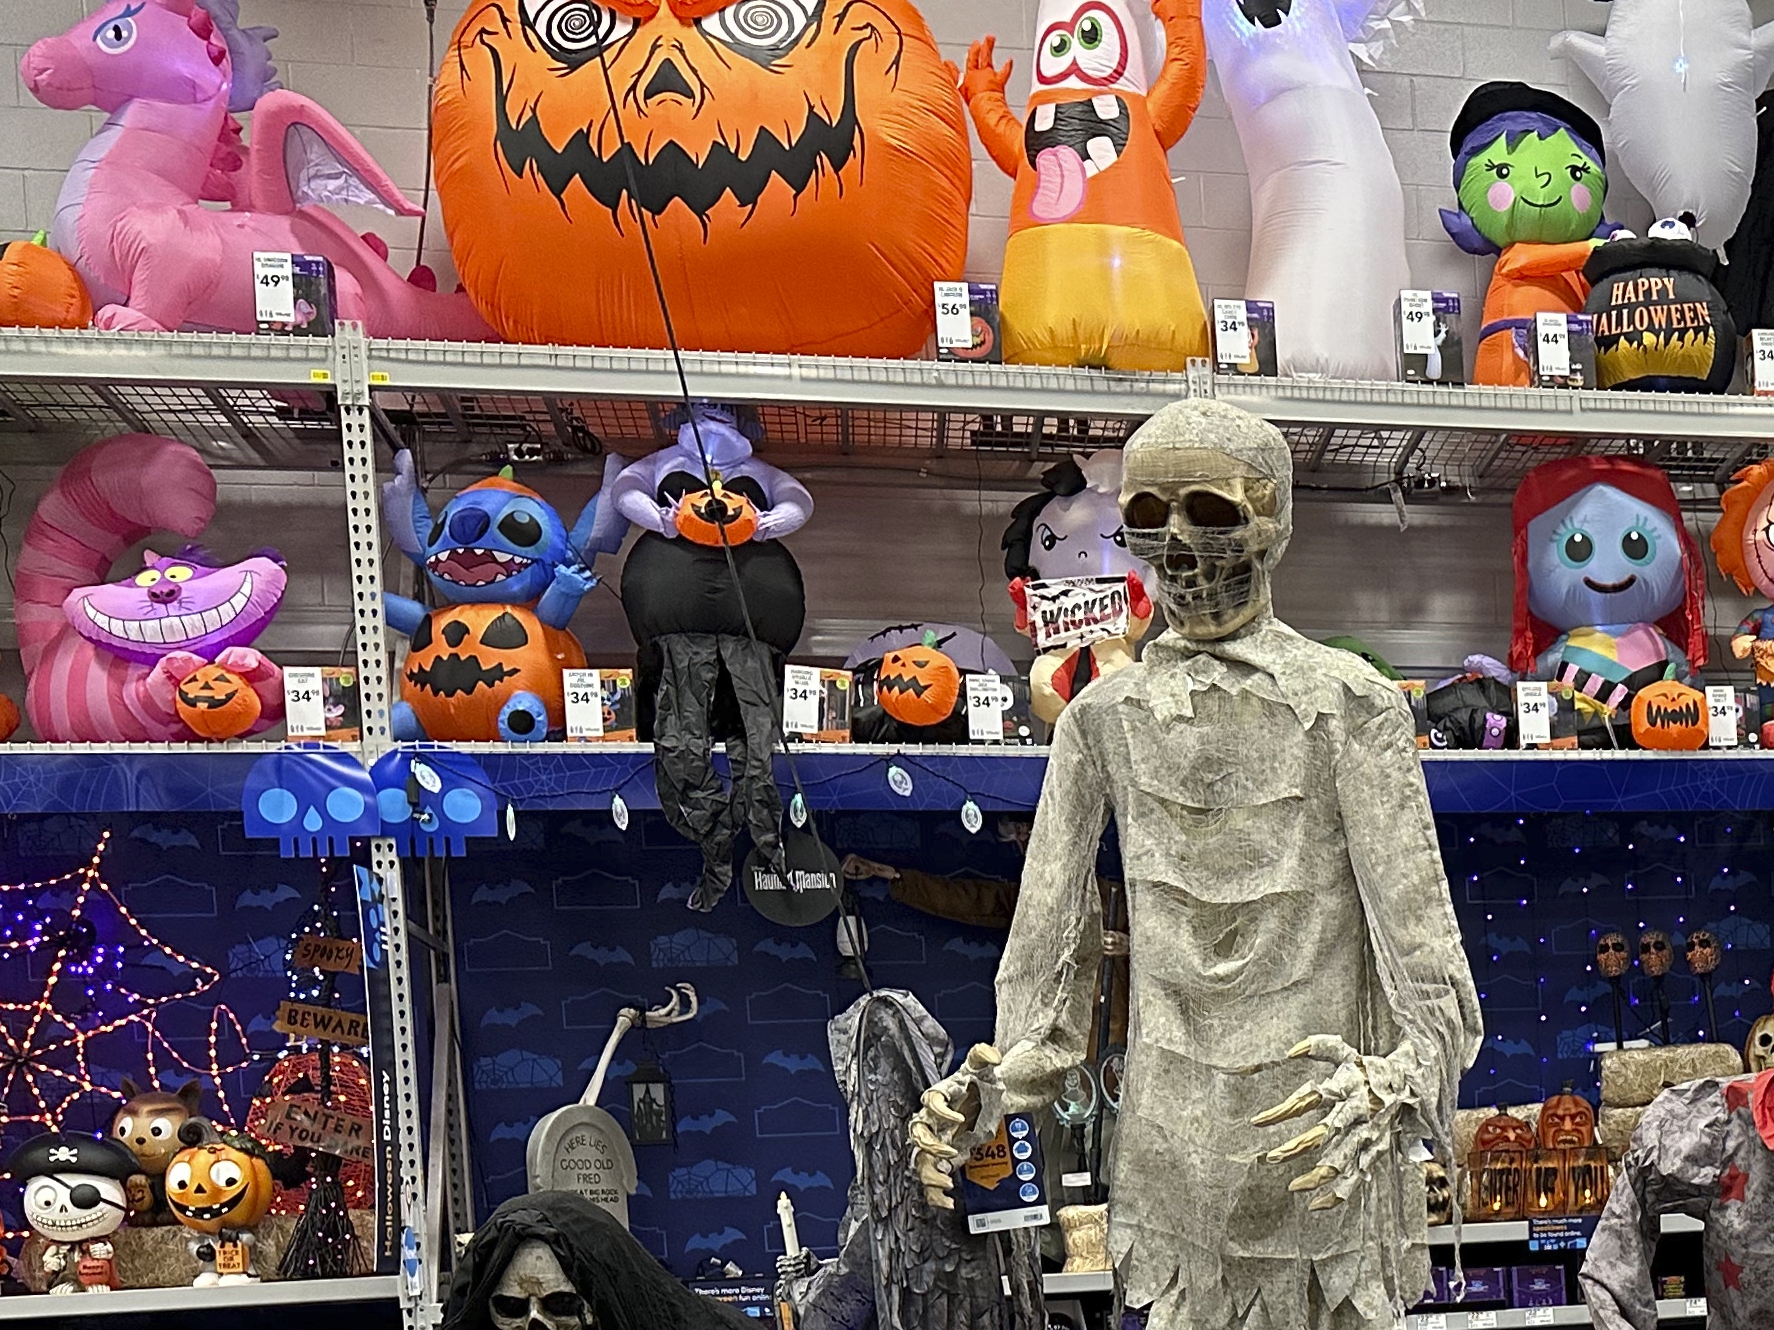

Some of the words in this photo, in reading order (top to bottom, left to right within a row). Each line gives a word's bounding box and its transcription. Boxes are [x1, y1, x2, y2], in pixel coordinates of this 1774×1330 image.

[1611, 277, 1675, 306] HAPPY
[1041, 590, 1124, 638] WICKED
[302, 943, 355, 968] SPOOKY
[383, 1070, 392, 1141] Disney
[267, 1122, 284, 1136] IF
[289, 1125, 322, 1144] YOU
[285, 1103, 363, 1139] ENTER
[564, 1134, 586, 1154] HERE
[589, 1135, 607, 1154] LIES
[560, 1159, 592, 1170] GOOD
[594, 1159, 613, 1170] OLD
[577, 1173, 601, 1184] FRED
[385, 1146, 393, 1257] Halloween
